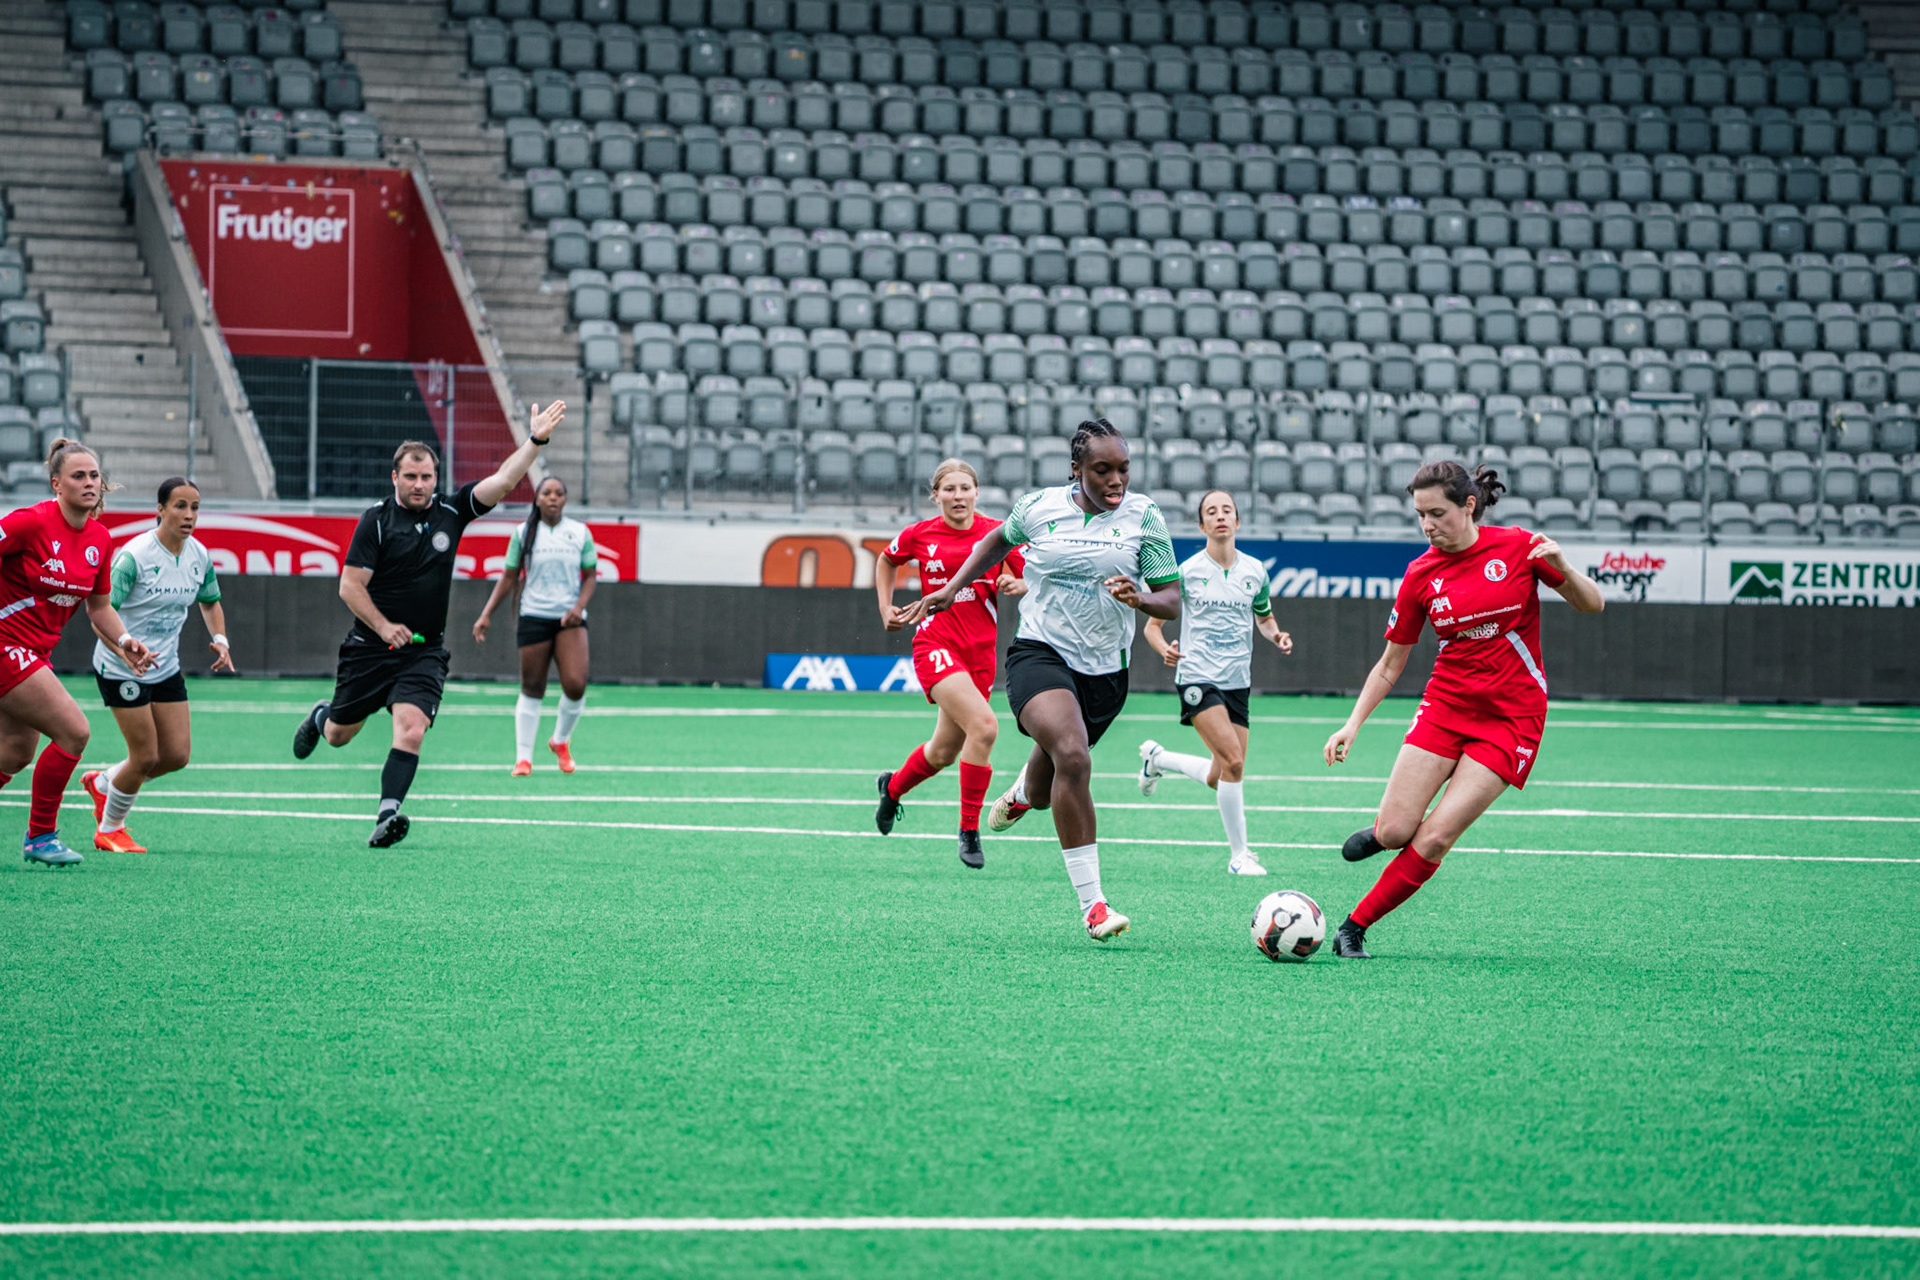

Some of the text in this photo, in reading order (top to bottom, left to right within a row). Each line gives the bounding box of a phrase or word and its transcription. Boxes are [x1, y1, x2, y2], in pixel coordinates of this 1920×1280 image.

[218, 204, 347, 250] Frutiger
[41, 558, 66, 574] AXA
[925, 559, 945, 573] AXA
[1599, 551, 1666, 573] Schuhe
[1588, 567, 1656, 592] Berger
[1792, 562, 1920, 589] ZENTRU
[1430, 596, 1453, 614] AXA
[782, 656, 858, 691] AXA
[928, 648, 954, 674] 21
